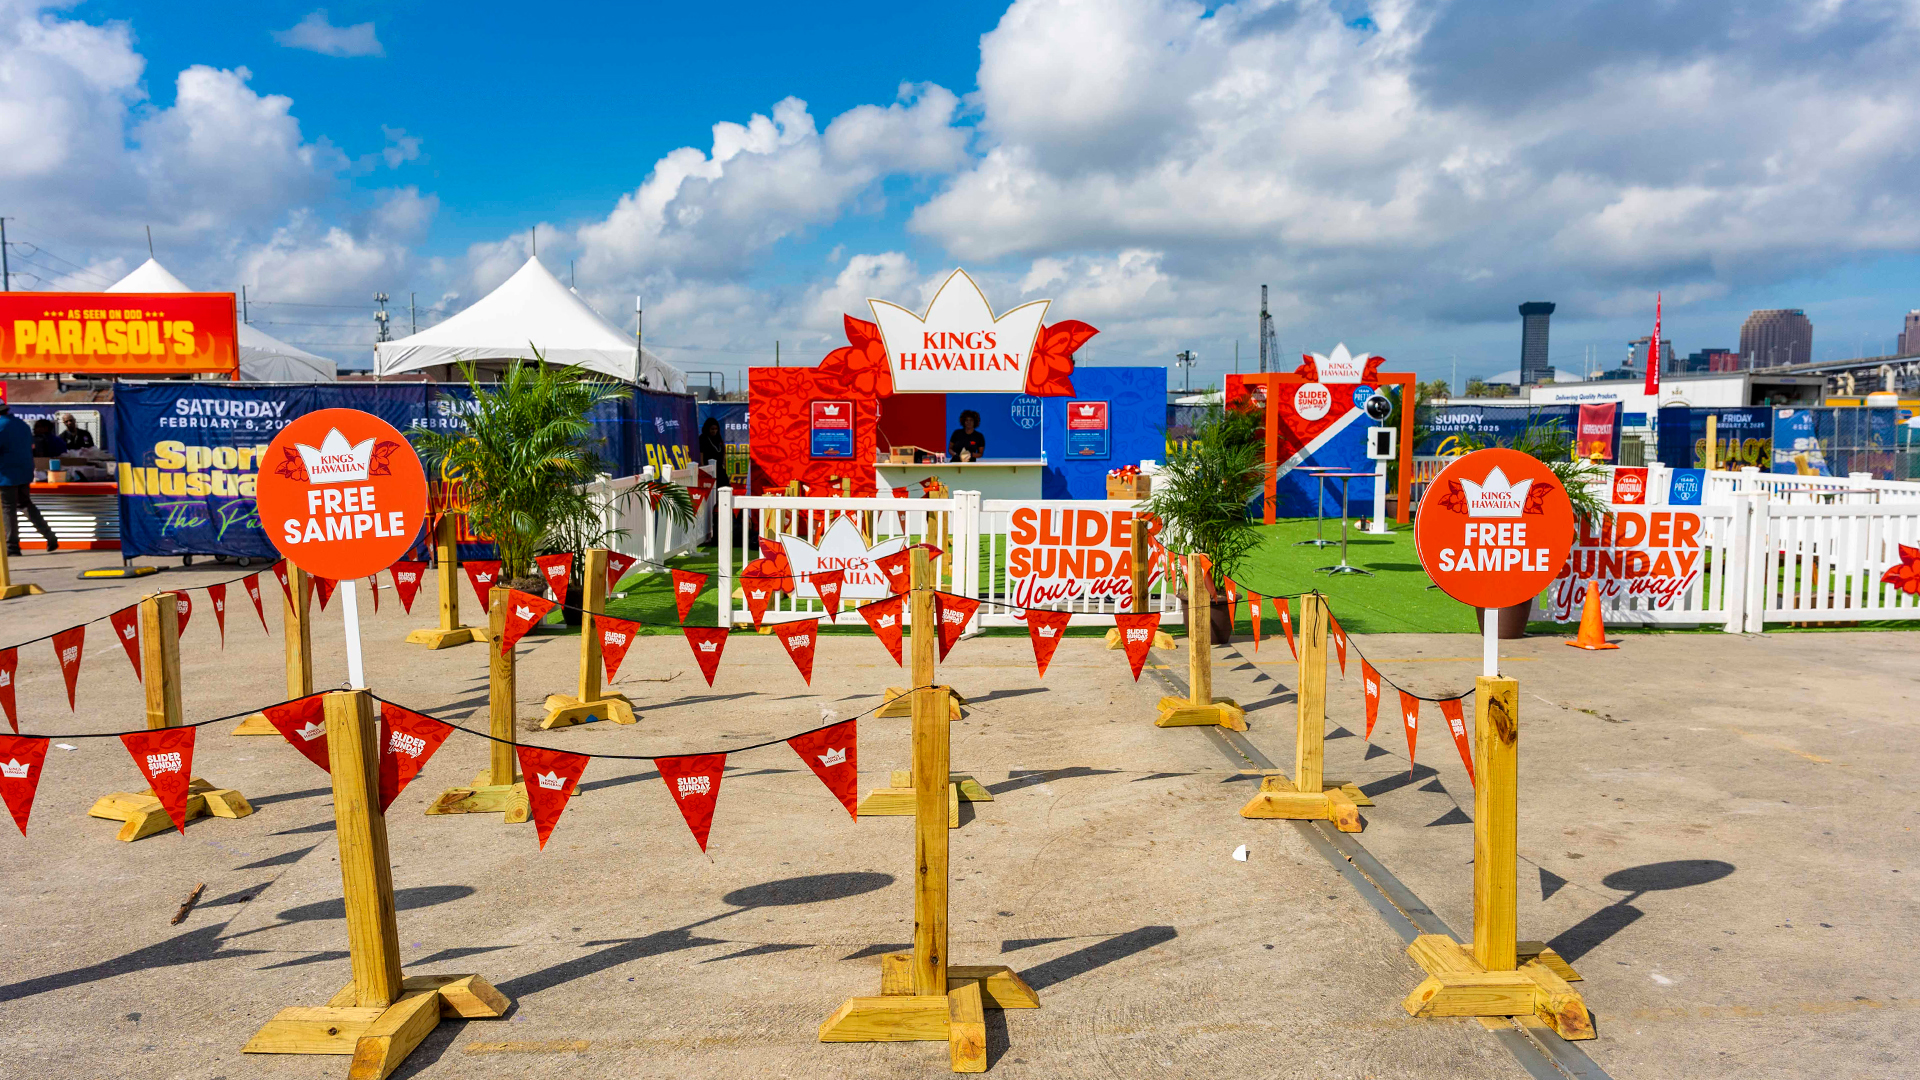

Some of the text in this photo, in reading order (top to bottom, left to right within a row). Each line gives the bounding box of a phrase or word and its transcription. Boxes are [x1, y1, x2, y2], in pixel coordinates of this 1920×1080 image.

[68, 310, 142, 319] AS SEEN ON DDD
[14, 320, 195, 355] PARASOL'S
[923, 331, 997, 350] KING'S
[900, 353, 1020, 371] HAWAIIAN
[176, 398, 286, 417] SATURDAY
[1011, 405, 1040, 417] PRETZE
[160, 417, 292, 431] FEBRUARY 8, 202
[1435, 414, 1484, 424] SUNDAY
[1723, 414, 1752, 422] FRIDAY
[154, 440, 268, 472] Sport
[320, 454, 354, 464] KING'S
[311, 463, 365, 474] HAWAIIAN
[118, 462, 257, 497] Illustra
[1617, 483, 1642, 492] ORIGINAL
[1674, 483, 1698, 492] PRETZEL
[308, 486, 376, 515] FREE
[1481, 491, 1511, 500] KING'S
[1471, 501, 1520, 509] HAWAIIAN
[153, 500, 208, 535] The
[284, 511, 405, 544] SAMPLE
[1464, 523, 1526, 546] FREE
[1573, 512, 1701, 548] LIDER
[817, 556, 869, 571] KING'S
[1438, 548, 1550, 572] SAMPLE
[1013, 573, 1081, 620] Your
[1555, 570, 1698, 621] Yor way!
[389, 739, 424, 754] SUNDAY
[392, 731, 426, 747] SLIDER
[147, 752, 181, 763] SLIDER
[148, 760, 182, 770] SUNDAY
[677, 776, 710, 786] SLIDER
[678, 783, 710, 792] SUNDAY
